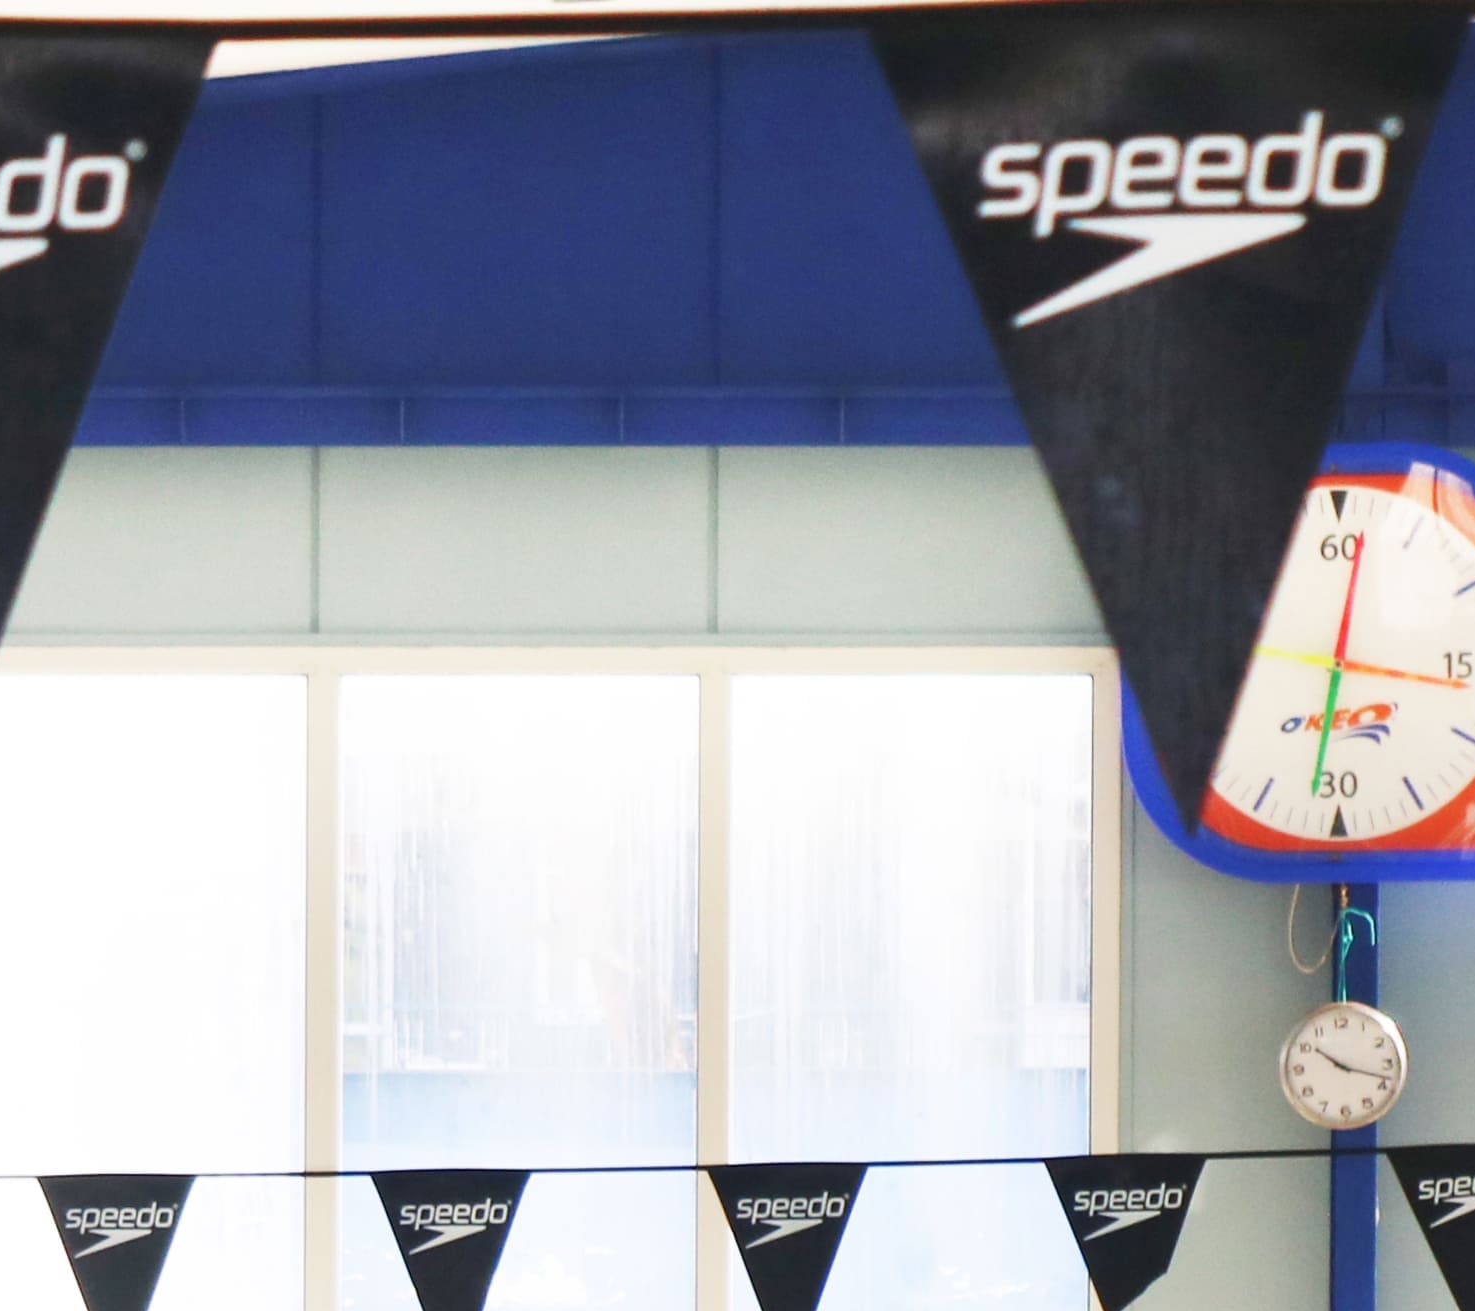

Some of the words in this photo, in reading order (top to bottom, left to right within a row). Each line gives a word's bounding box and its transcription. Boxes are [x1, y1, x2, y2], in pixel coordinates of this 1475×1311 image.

[977, 110, 1384, 236] speedo
[1320, 535, 1359, 561] 60
[1442, 652, 1473, 678] 15
[1319, 771, 1357, 798] 30
[400, 1198, 507, 1229] speedo
[736, 1192, 844, 1223] speedo
[1074, 1184, 1182, 1215] speedo
[66, 1202, 173, 1232] speedo
